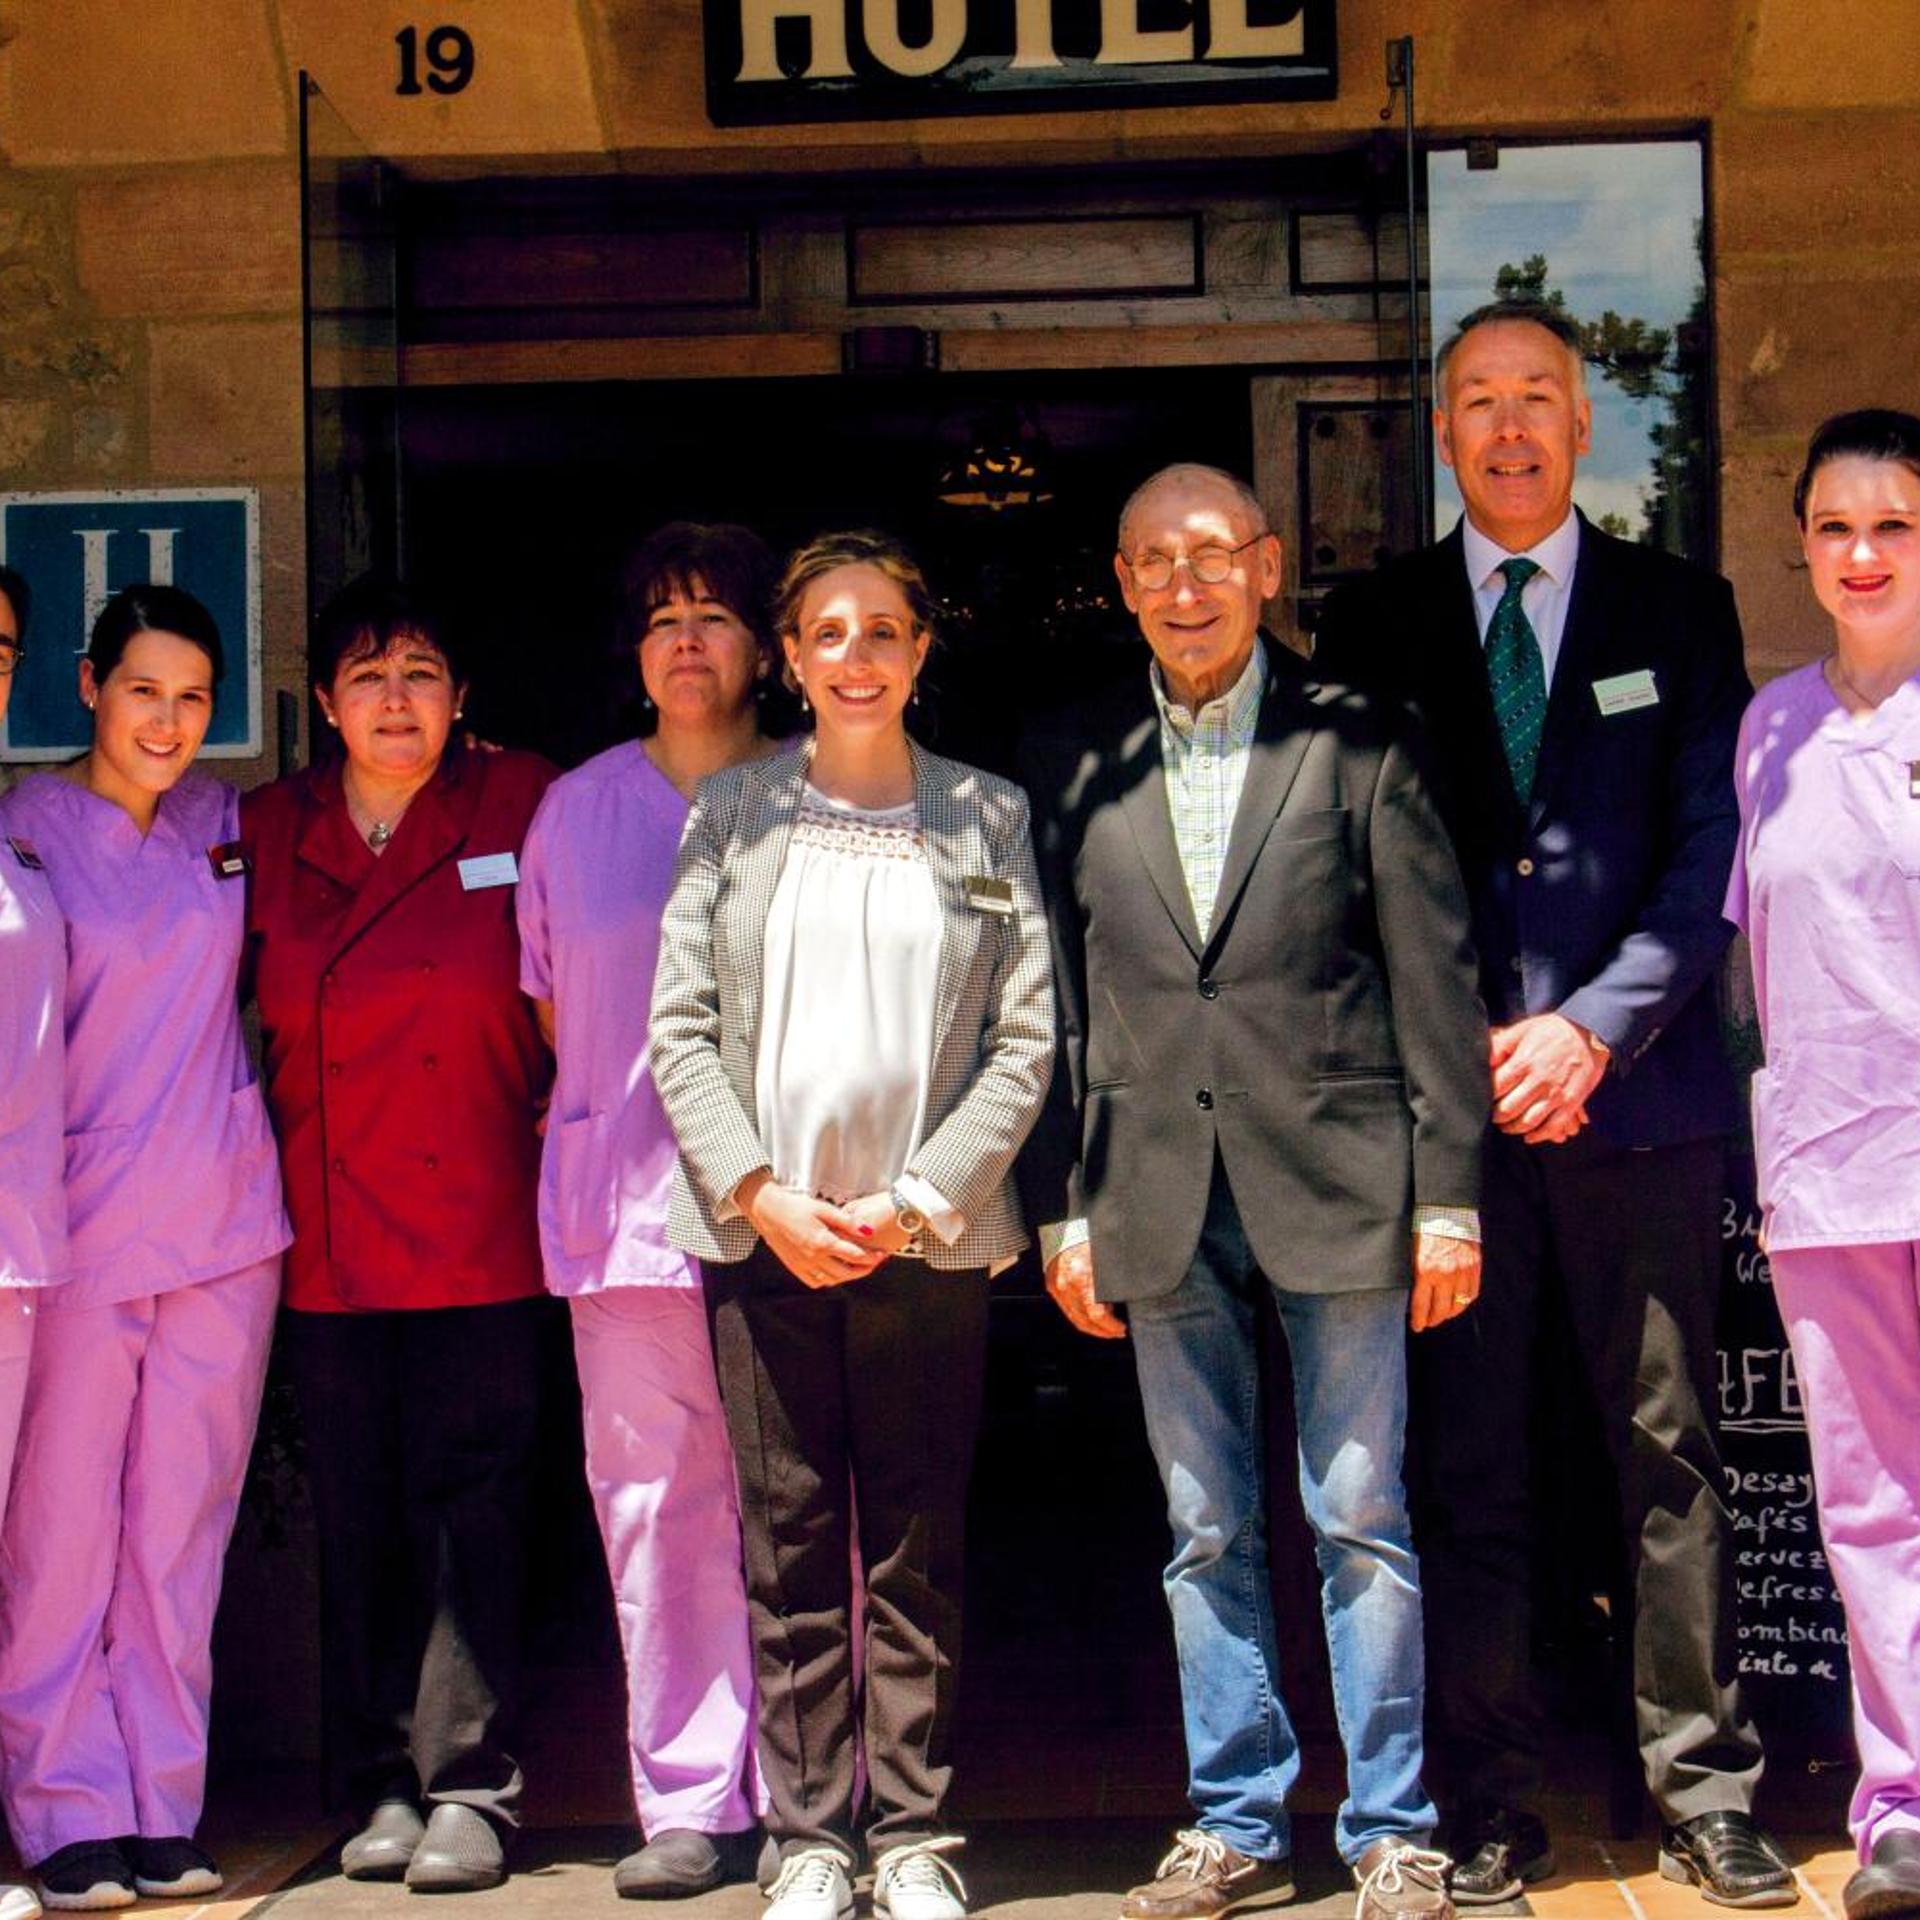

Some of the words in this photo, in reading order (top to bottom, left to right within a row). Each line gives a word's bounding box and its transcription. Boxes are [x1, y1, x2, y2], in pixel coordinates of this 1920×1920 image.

[394, 26, 475, 95] 19
[1732, 1506, 1808, 1545] afés
[1735, 1549, 1826, 1569] ervez
[1737, 1616, 1848, 1644] ombin
[1738, 1650, 1799, 1675] into
